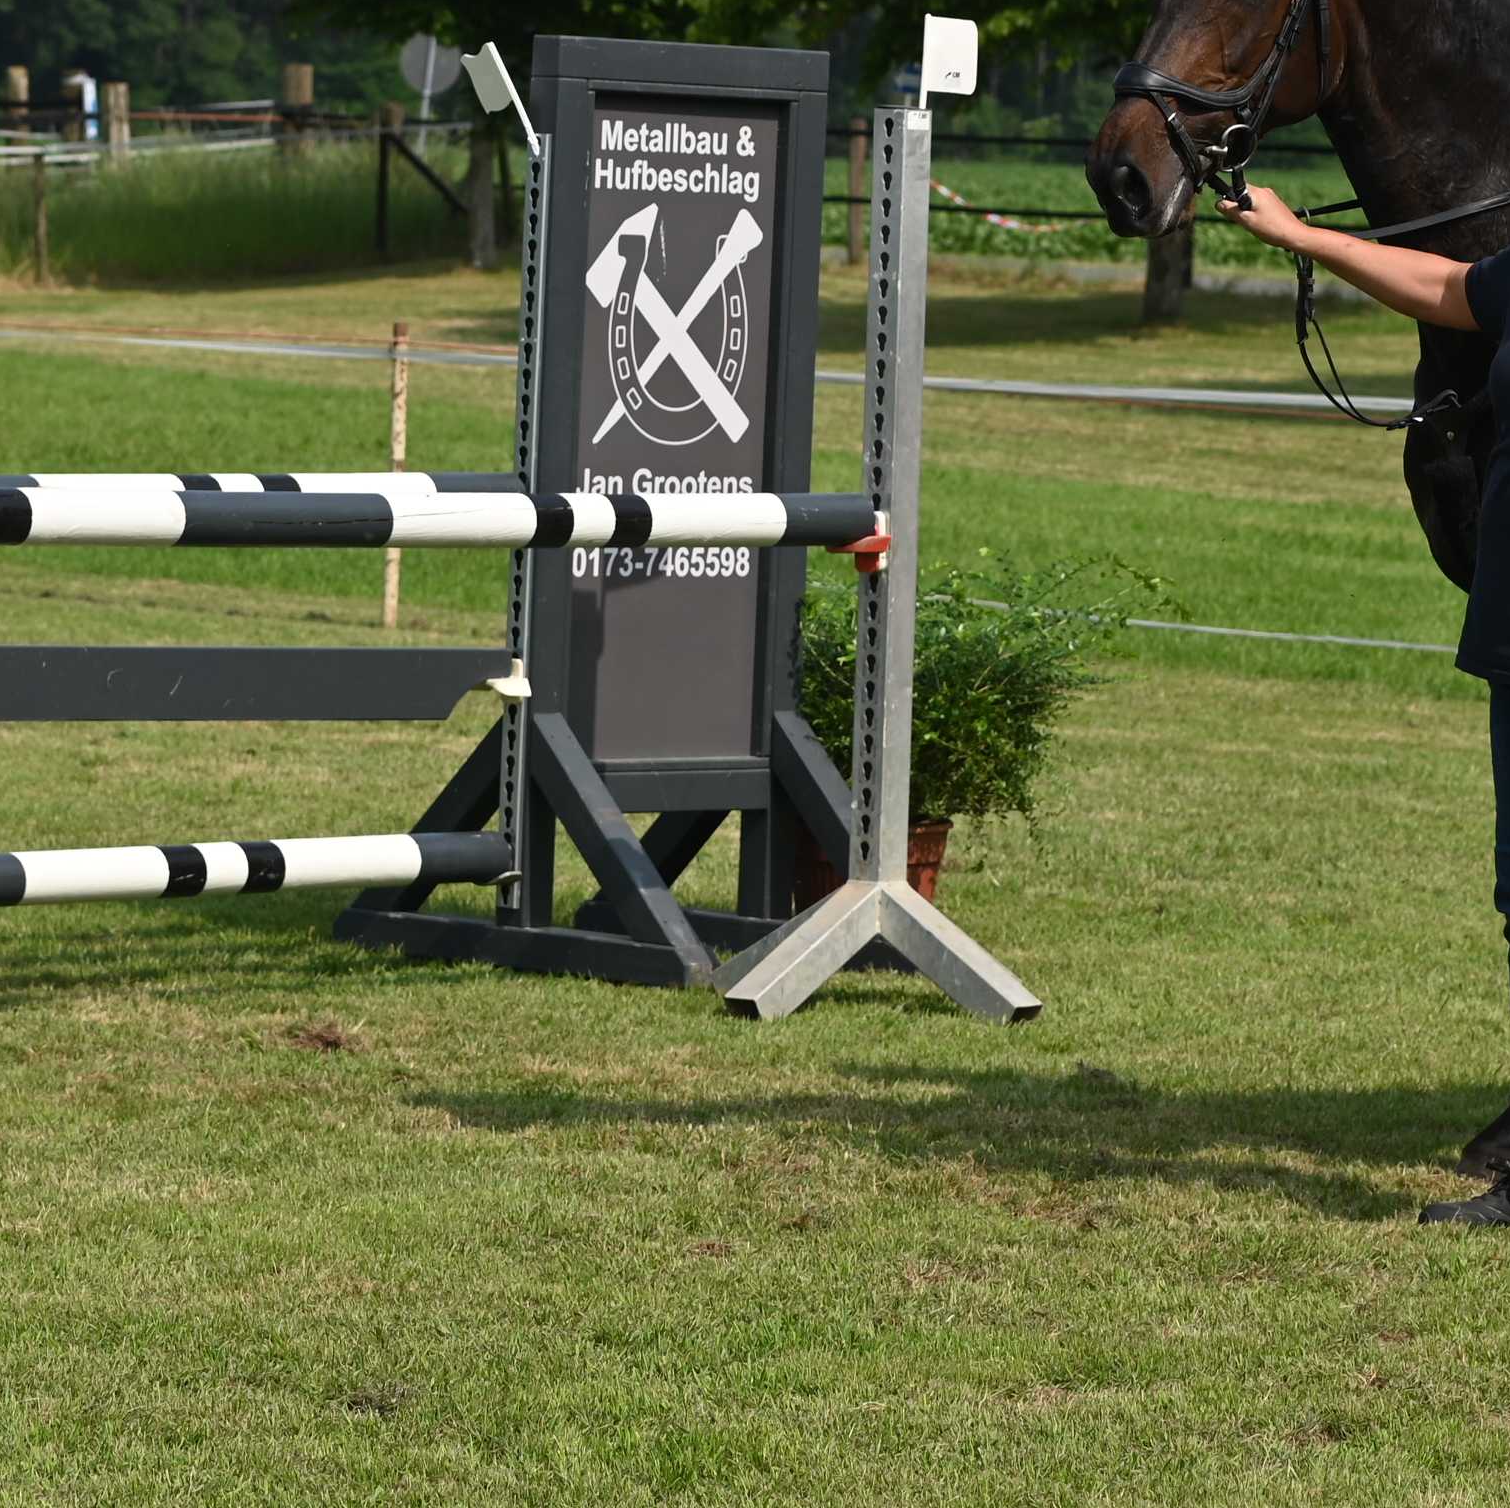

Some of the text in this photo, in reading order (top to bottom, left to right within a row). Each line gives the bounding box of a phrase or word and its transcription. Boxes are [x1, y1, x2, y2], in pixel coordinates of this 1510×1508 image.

[600, 119, 756, 157] Metallbau &
[593, 158, 760, 202] Hufbeschlag
[576, 467, 754, 494] Jan Grootens
[571, 546, 751, 579] 0173-7465598
